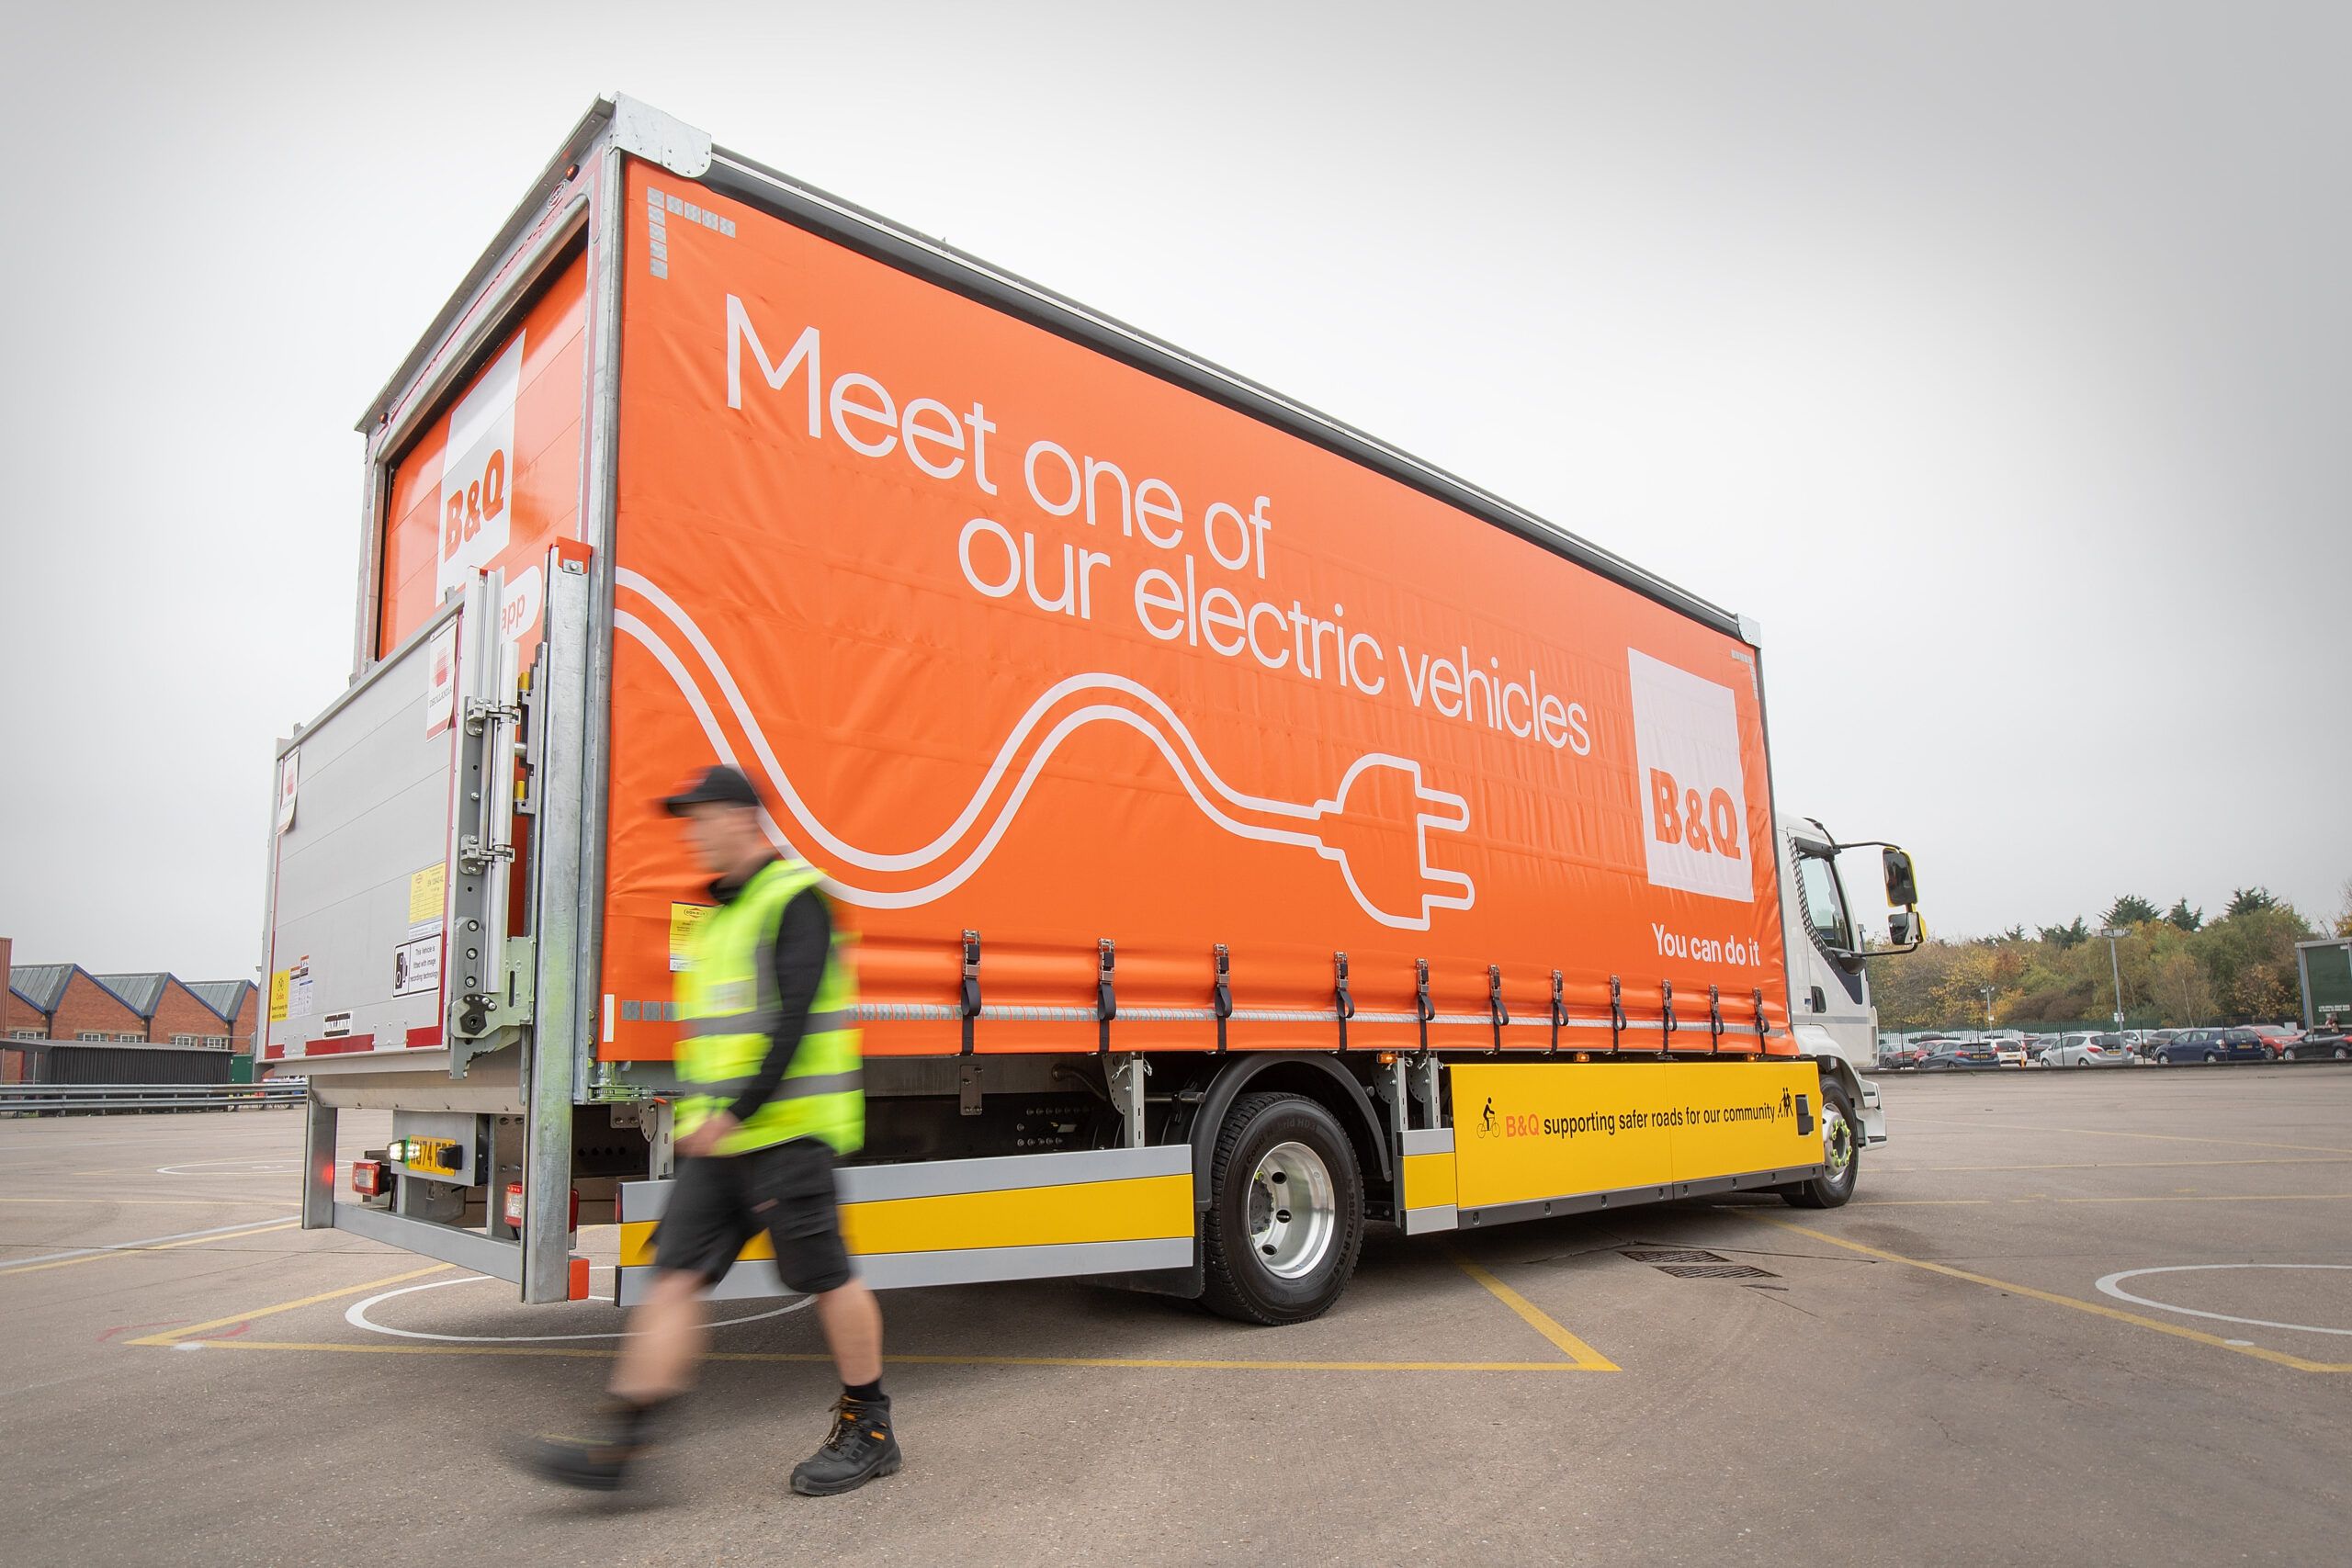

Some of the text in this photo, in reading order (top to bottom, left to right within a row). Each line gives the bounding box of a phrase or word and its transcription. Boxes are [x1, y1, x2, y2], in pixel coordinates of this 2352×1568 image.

[727, 293, 1272, 579] Meet one of
[445, 449, 505, 563] B&Q
[959, 518, 1591, 756] our electric vehicles
[1650, 768, 1741, 861] B&Q
[1652, 922, 1761, 967] You can do it
[1505, 1102, 1776, 1139] B&Q supporting safer roads for our community
[1346, 1193, 1356, 1240] 285/70
